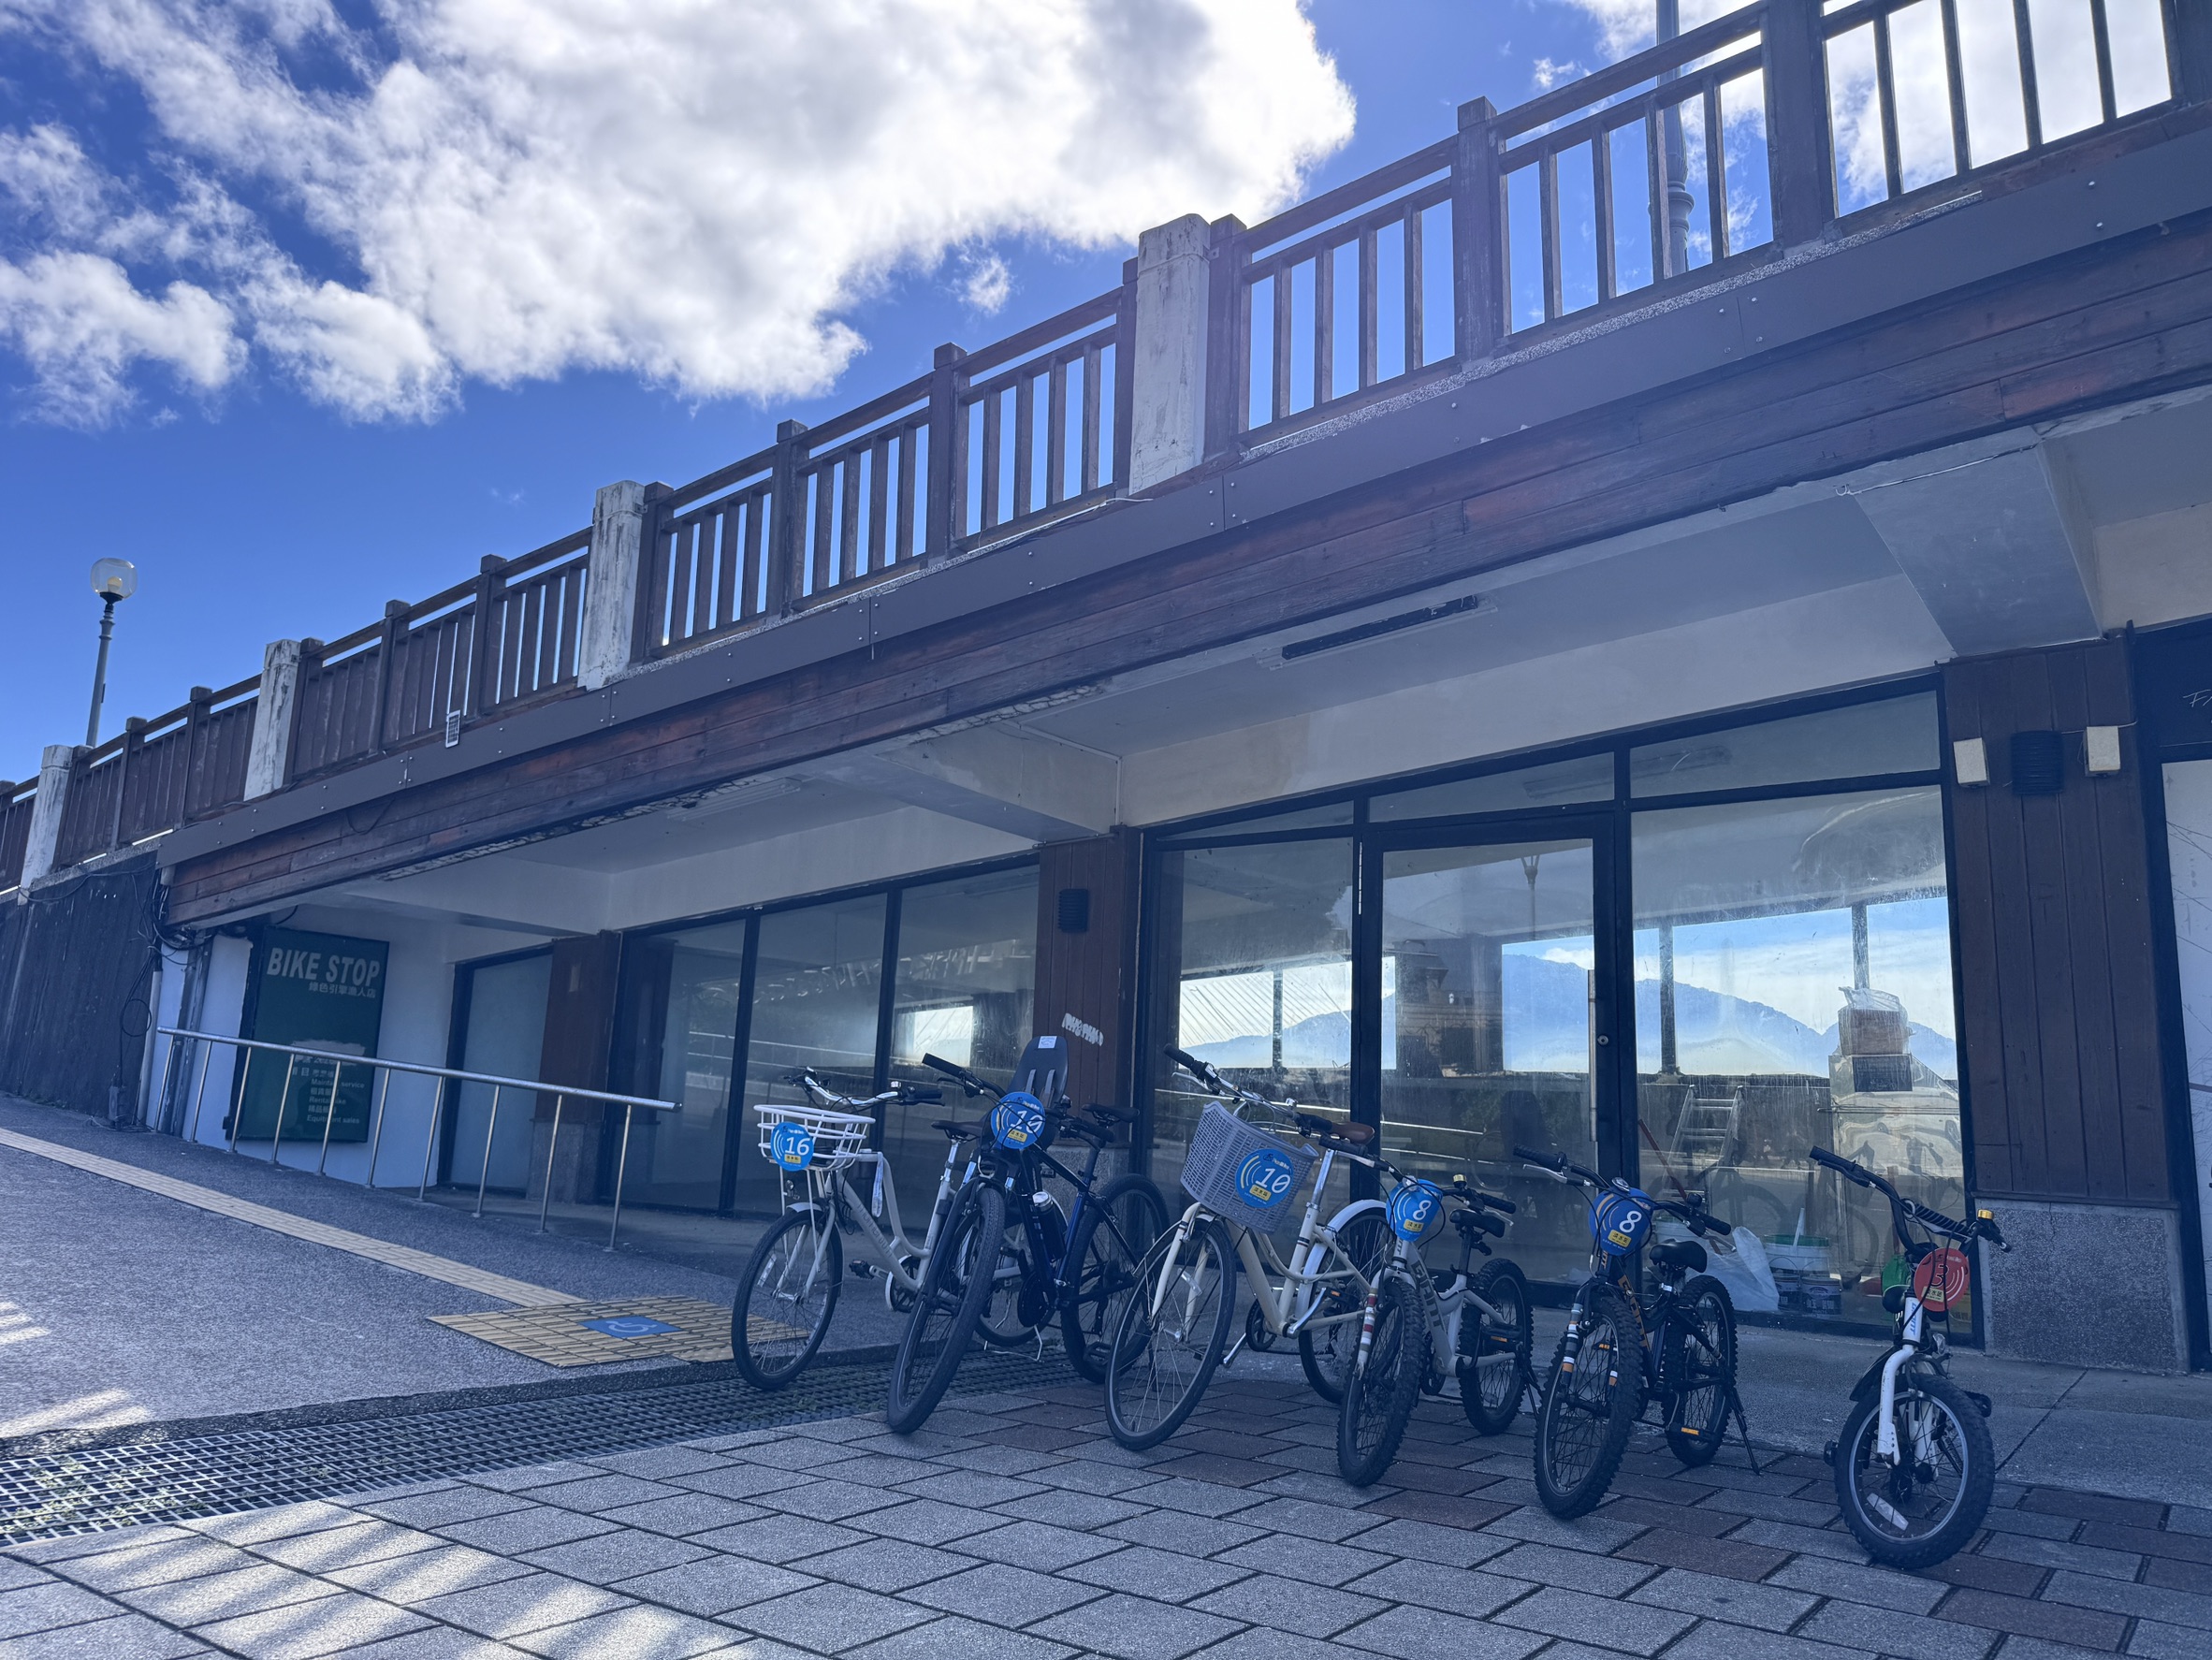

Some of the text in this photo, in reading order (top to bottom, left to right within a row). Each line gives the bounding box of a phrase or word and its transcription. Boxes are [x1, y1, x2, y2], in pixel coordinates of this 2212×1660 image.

[267, 947, 380, 987] BIKE STOP
[1011, 1111, 1043, 1133] 10
[785, 1137, 810, 1156] 16
[1255, 1168, 1291, 1194] 10
[1412, 1200, 1432, 1220] 8
[1619, 1210, 1642, 1232] 8
[1930, 1263, 1950, 1289] 3
